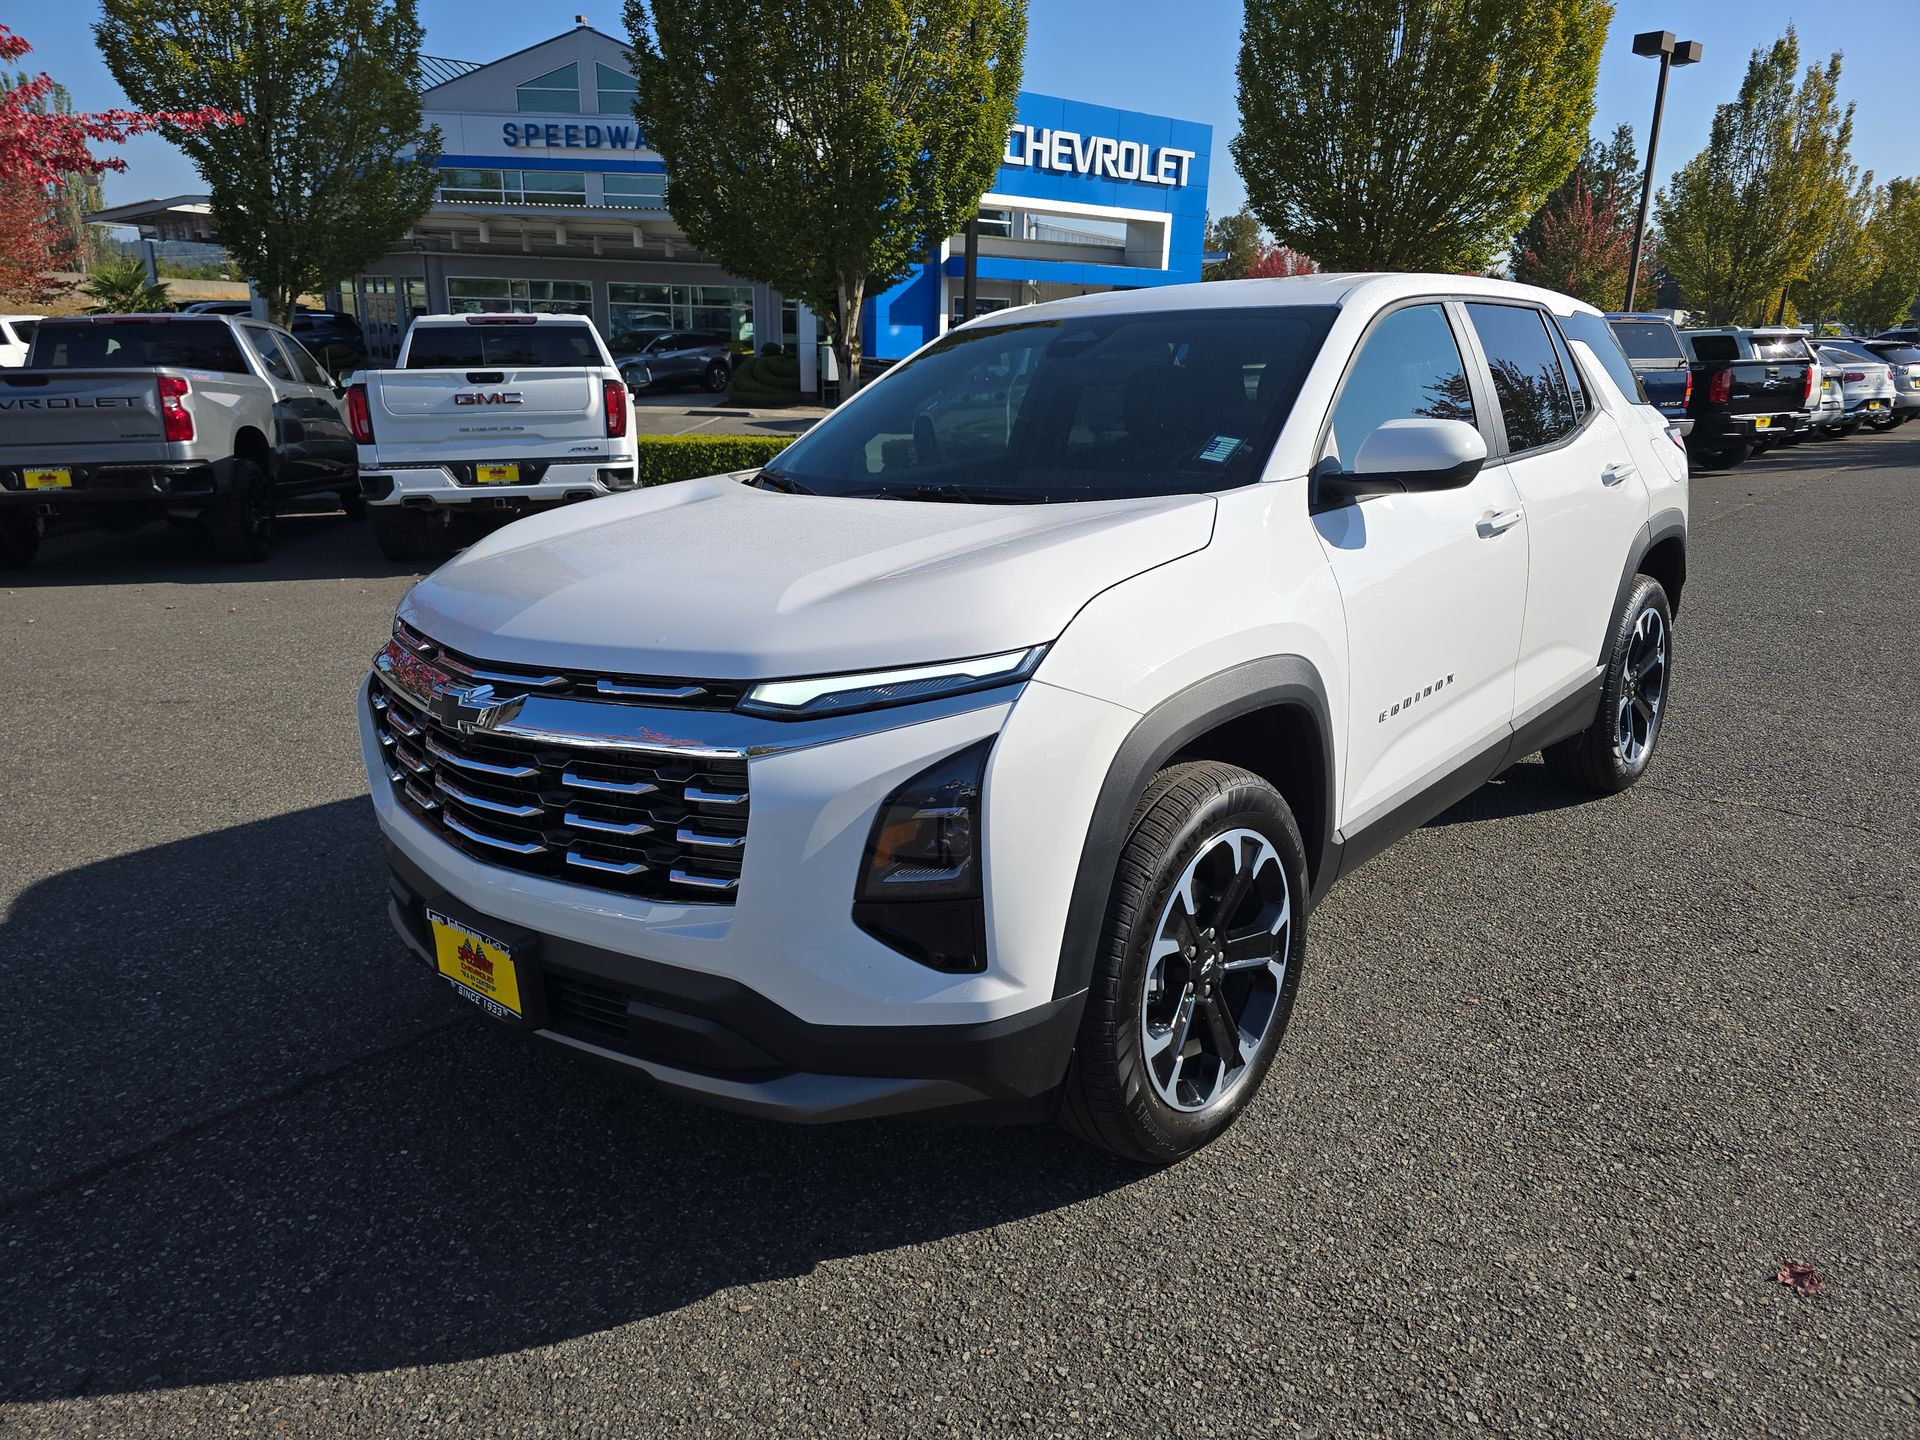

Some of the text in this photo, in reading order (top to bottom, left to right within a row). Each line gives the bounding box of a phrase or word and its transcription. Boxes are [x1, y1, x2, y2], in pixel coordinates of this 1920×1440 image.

[1002, 123, 1196, 187] CHEVROLET
[454, 391, 524, 406] GMC
[1378, 673, 1455, 724] EQUINOX
[458, 985, 481, 1005] SINCE
[483, 1002, 503, 1017] 1933
